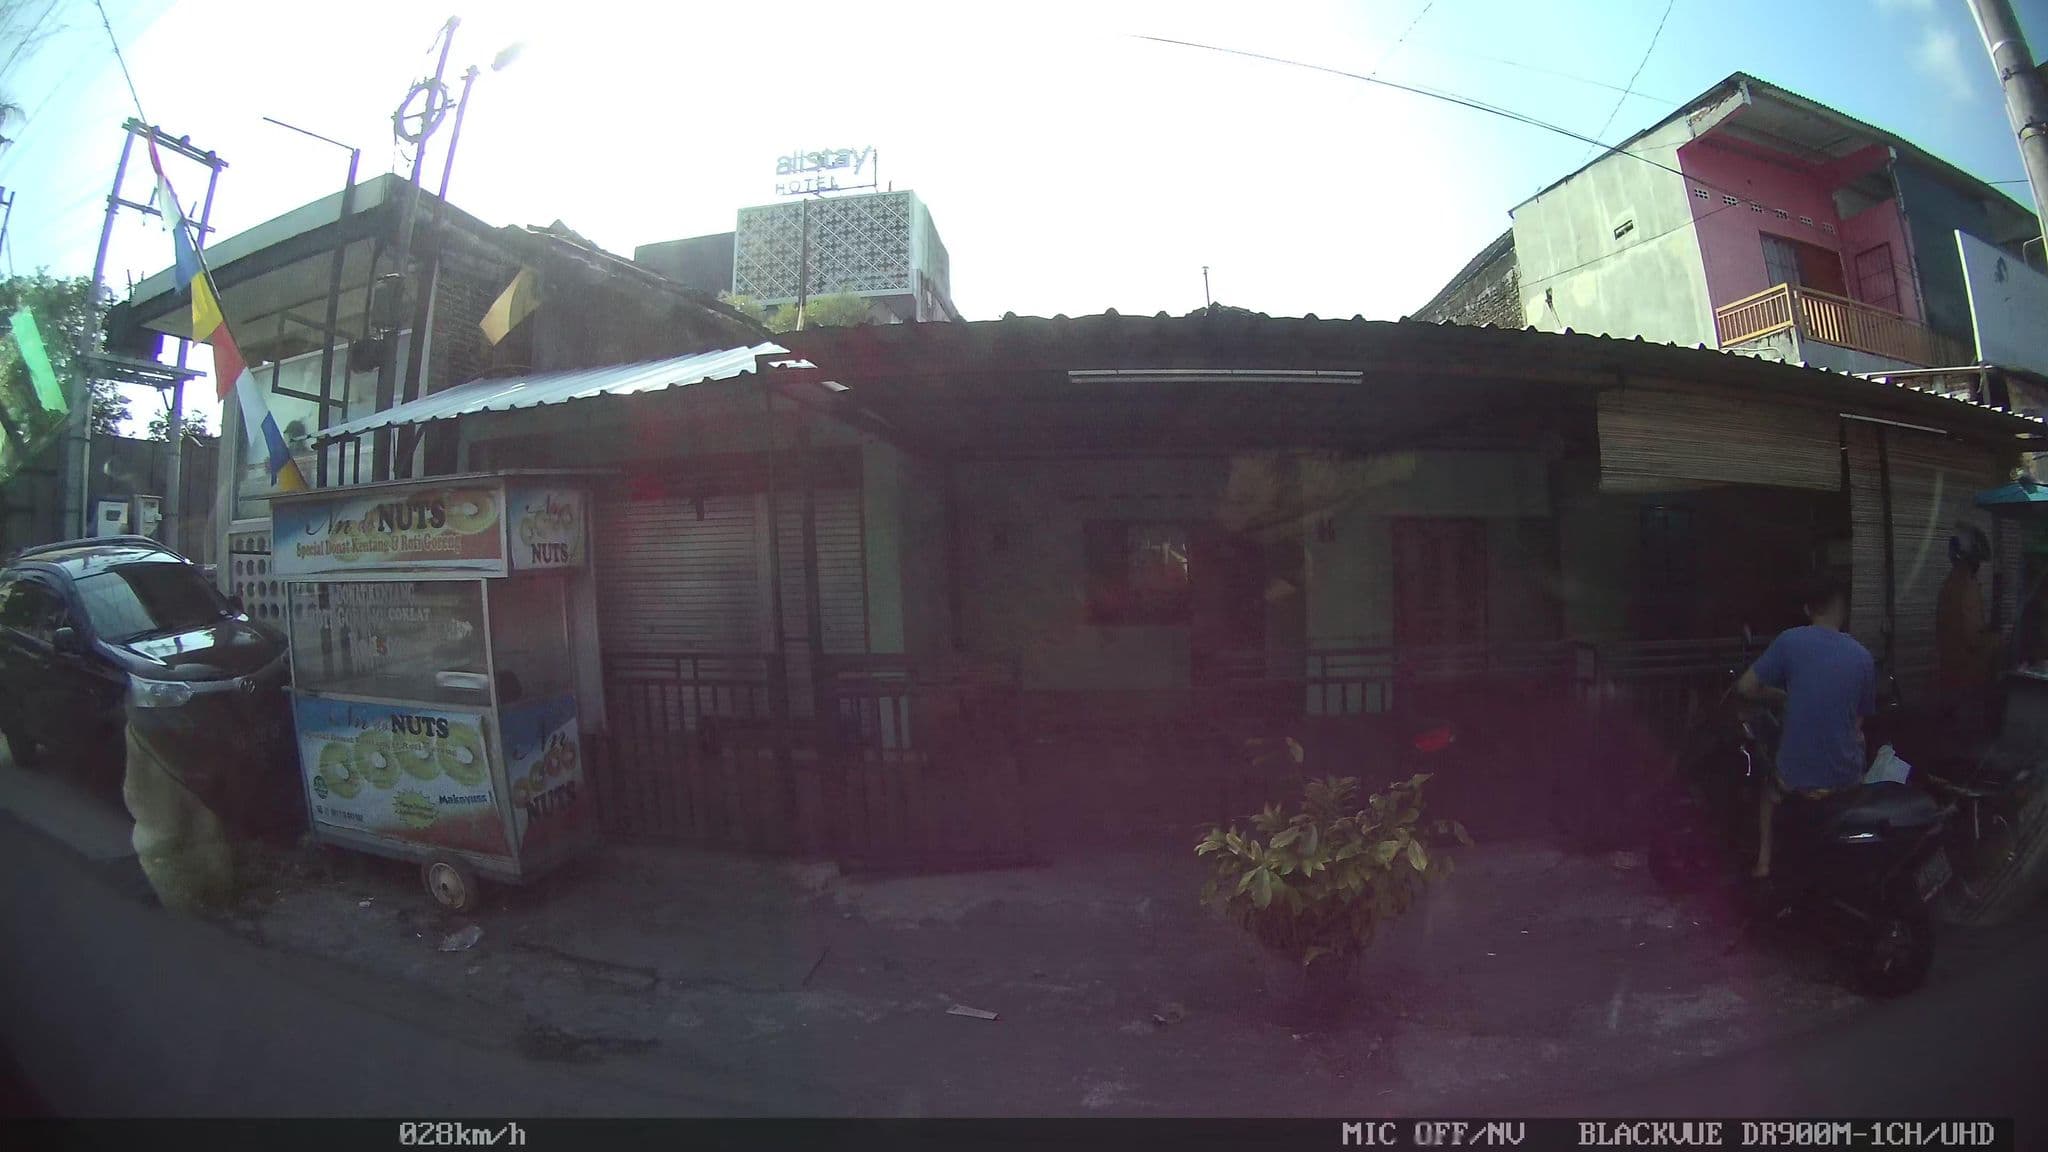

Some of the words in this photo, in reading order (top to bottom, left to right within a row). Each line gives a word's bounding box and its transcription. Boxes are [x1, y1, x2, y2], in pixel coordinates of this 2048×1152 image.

[776, 145, 872, 175] allstay
[776, 176, 840, 194] HOTEL
[296, 540, 324, 558] Special
[531, 543, 569, 564] NUTS
[391, 713, 449, 739] NUTS
